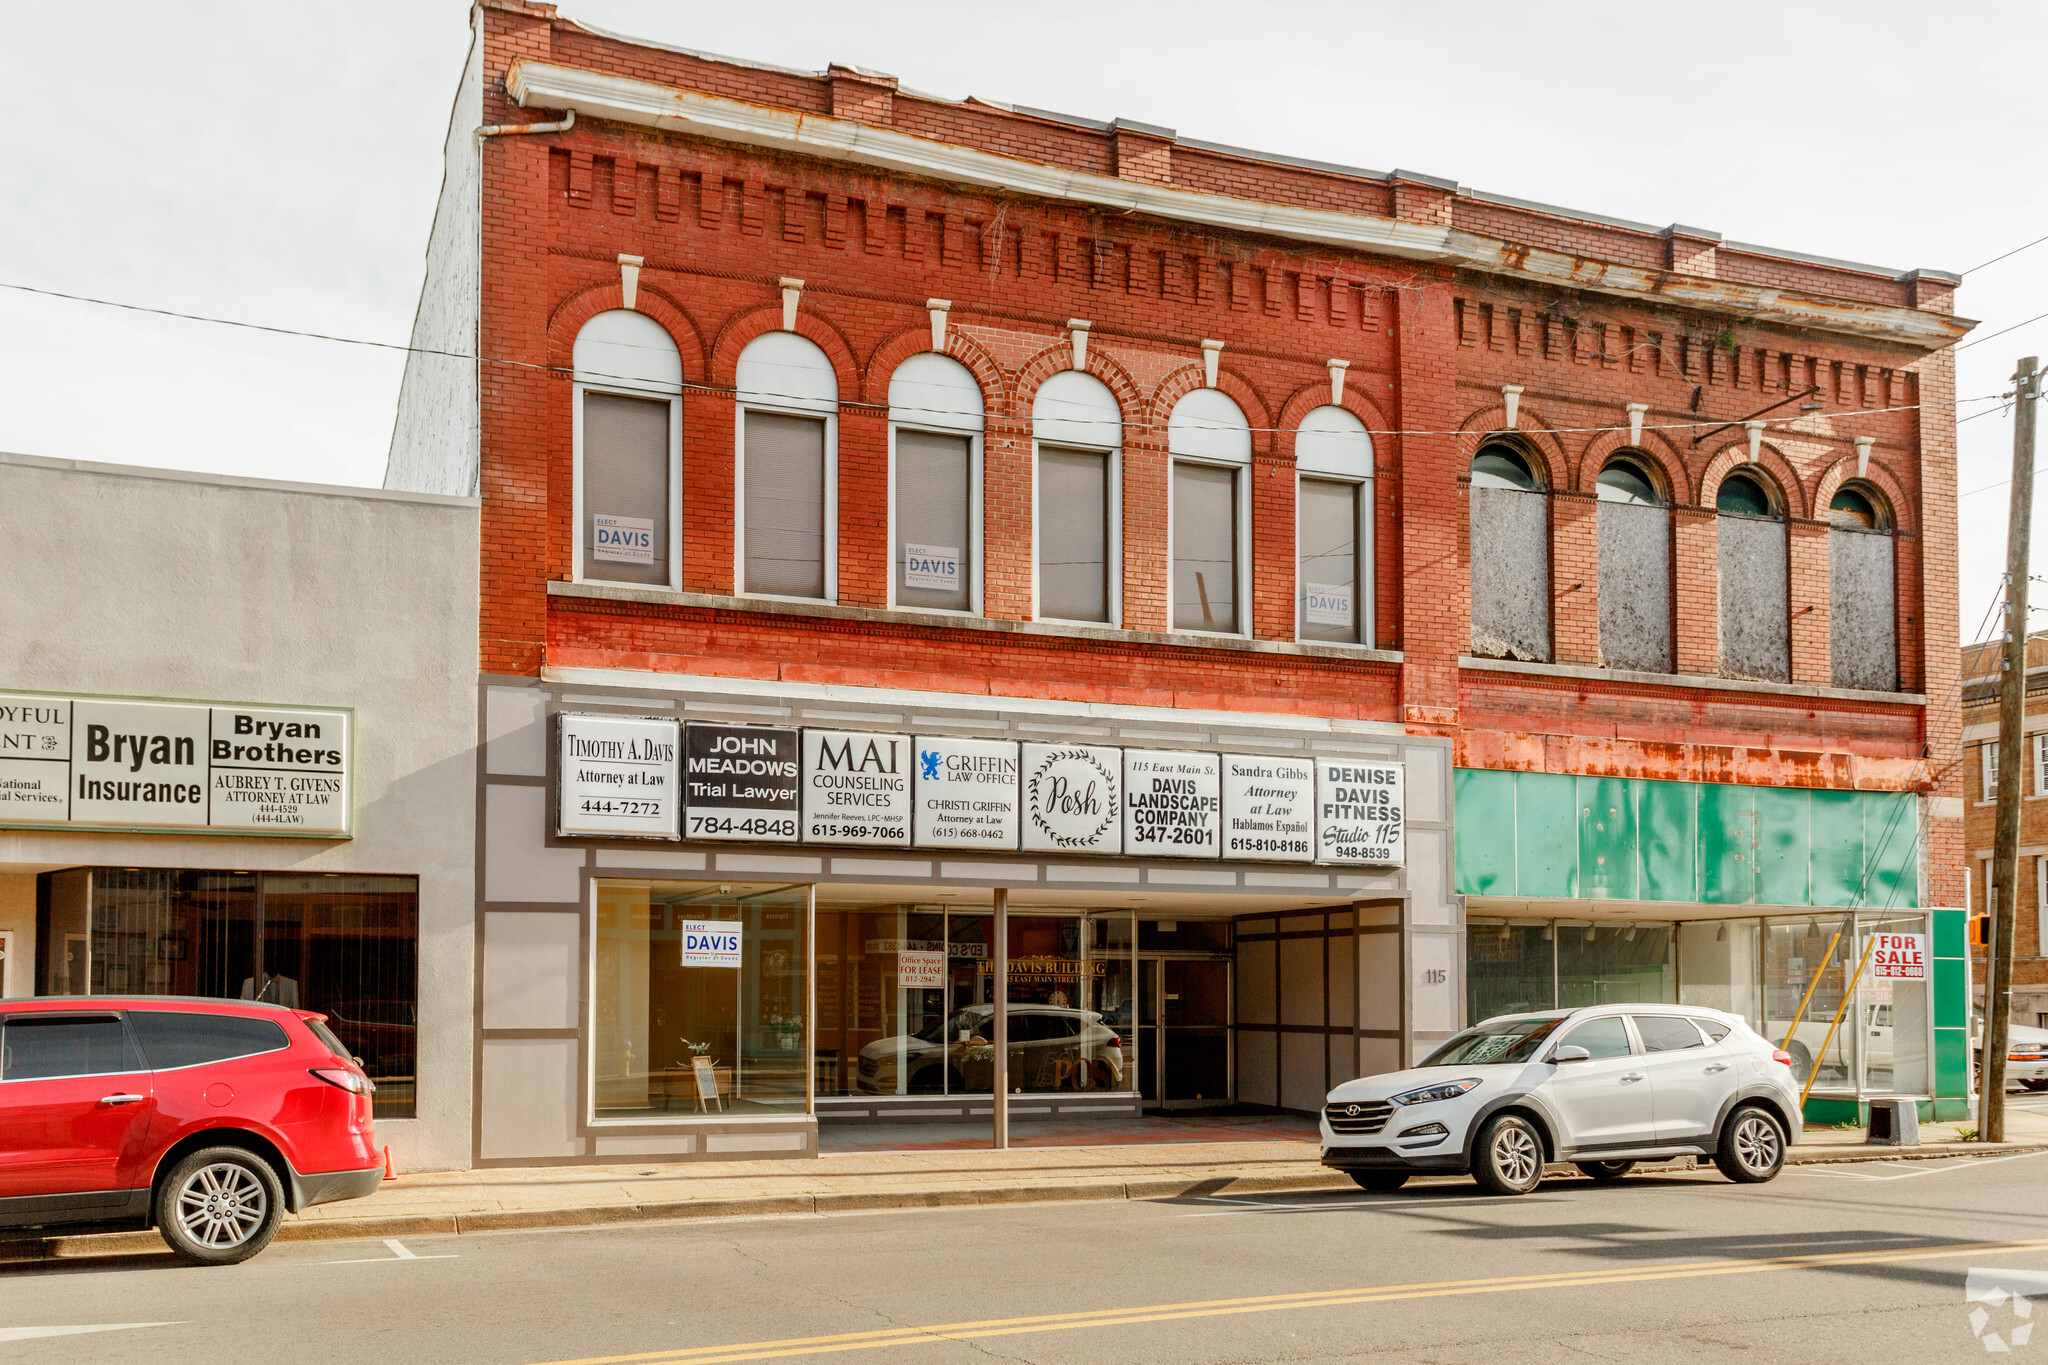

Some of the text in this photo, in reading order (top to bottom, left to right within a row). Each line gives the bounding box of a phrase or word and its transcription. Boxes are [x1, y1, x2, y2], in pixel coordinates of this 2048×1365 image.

[599, 529, 649, 547] DAVIS
[910, 558, 955, 574] DAVIS
[1310, 595, 1348, 611] DAVIS
[0, 706, 64, 724] YFUL
[234, 715, 320, 741] Bryan
[0, 733, 36, 749] NT
[87, 724, 194, 772] Bryan
[568, 734, 673, 762] TIMOTHY A. DAVIS
[710, 736, 776, 755] JOHN
[212, 739, 341, 765] Brothers
[815, 736, 900, 774] MAI
[689, 758, 797, 777] MEADOWS
[946, 754, 1016, 773] GRIFFIN
[1133, 762, 1216, 776] 115 East Main St.
[577, 769, 665, 787] Attorney at Law
[947, 772, 1016, 785] LAW OFFICE
[1231, 765, 1308, 780] Sandra Gibbs
[1328, 767, 1396, 785] DENISE
[79, 774, 201, 804] Insurance
[215, 775, 340, 792] AUBREY T. GIVENS
[813, 775, 904, 792] COUNSELING
[1152, 778, 1196, 795] DAVIS
[225, 791, 330, 805] ATTORNEY AT LAW
[689, 783, 797, 801] Trial Lawyer
[827, 792, 891, 807] SERVICES
[1045, 775, 1102, 816] Posh
[1244, 785, 1298, 802] Attorney
[1336, 788, 1390, 804] DAVIS
[259, 804, 298, 814] 444-4529
[581, 800, 660, 815] 444-7272
[927, 799, 1011, 812] CHRISTI GRIFFIN
[1129, 793, 1218, 812] LANDSCAPE
[1250, 804, 1292, 816] at Law
[252, 814, 304, 824] (444-4LAW)
[813, 812, 904, 822] Jennifer Reeves, LPC-MHSP
[937, 814, 1003, 825] Attorney at Law
[1135, 809, 1208, 827] COMPANY
[1323, 804, 1401, 822] FITNESS
[690, 817, 795, 836] 784-4848
[812, 824, 904, 838] 615-969-7066
[932, 826, 1004, 839] (615) 668-0462
[1232, 818, 1308, 835] Hablamos Español
[1323, 822, 1402, 847] Studio 115
[1135, 826, 1213, 845] 347-2601
[1231, 838, 1308, 852] 615-810-8186
[1336, 847, 1390, 859] 948-8539
[687, 936, 738, 950] DAVIS
[1880, 936, 1916, 949] FOR
[901, 956, 941, 966] Office Space
[1875, 950, 1923, 964] SALE
[900, 966, 942, 975] FOR LEASE
[976, 961, 1105, 974] TH DAVIS BUILDING
[905, 975, 935, 983] 812-2947
[1015, 975, 1032, 983] EAST
[1426, 969, 1446, 984] 115
